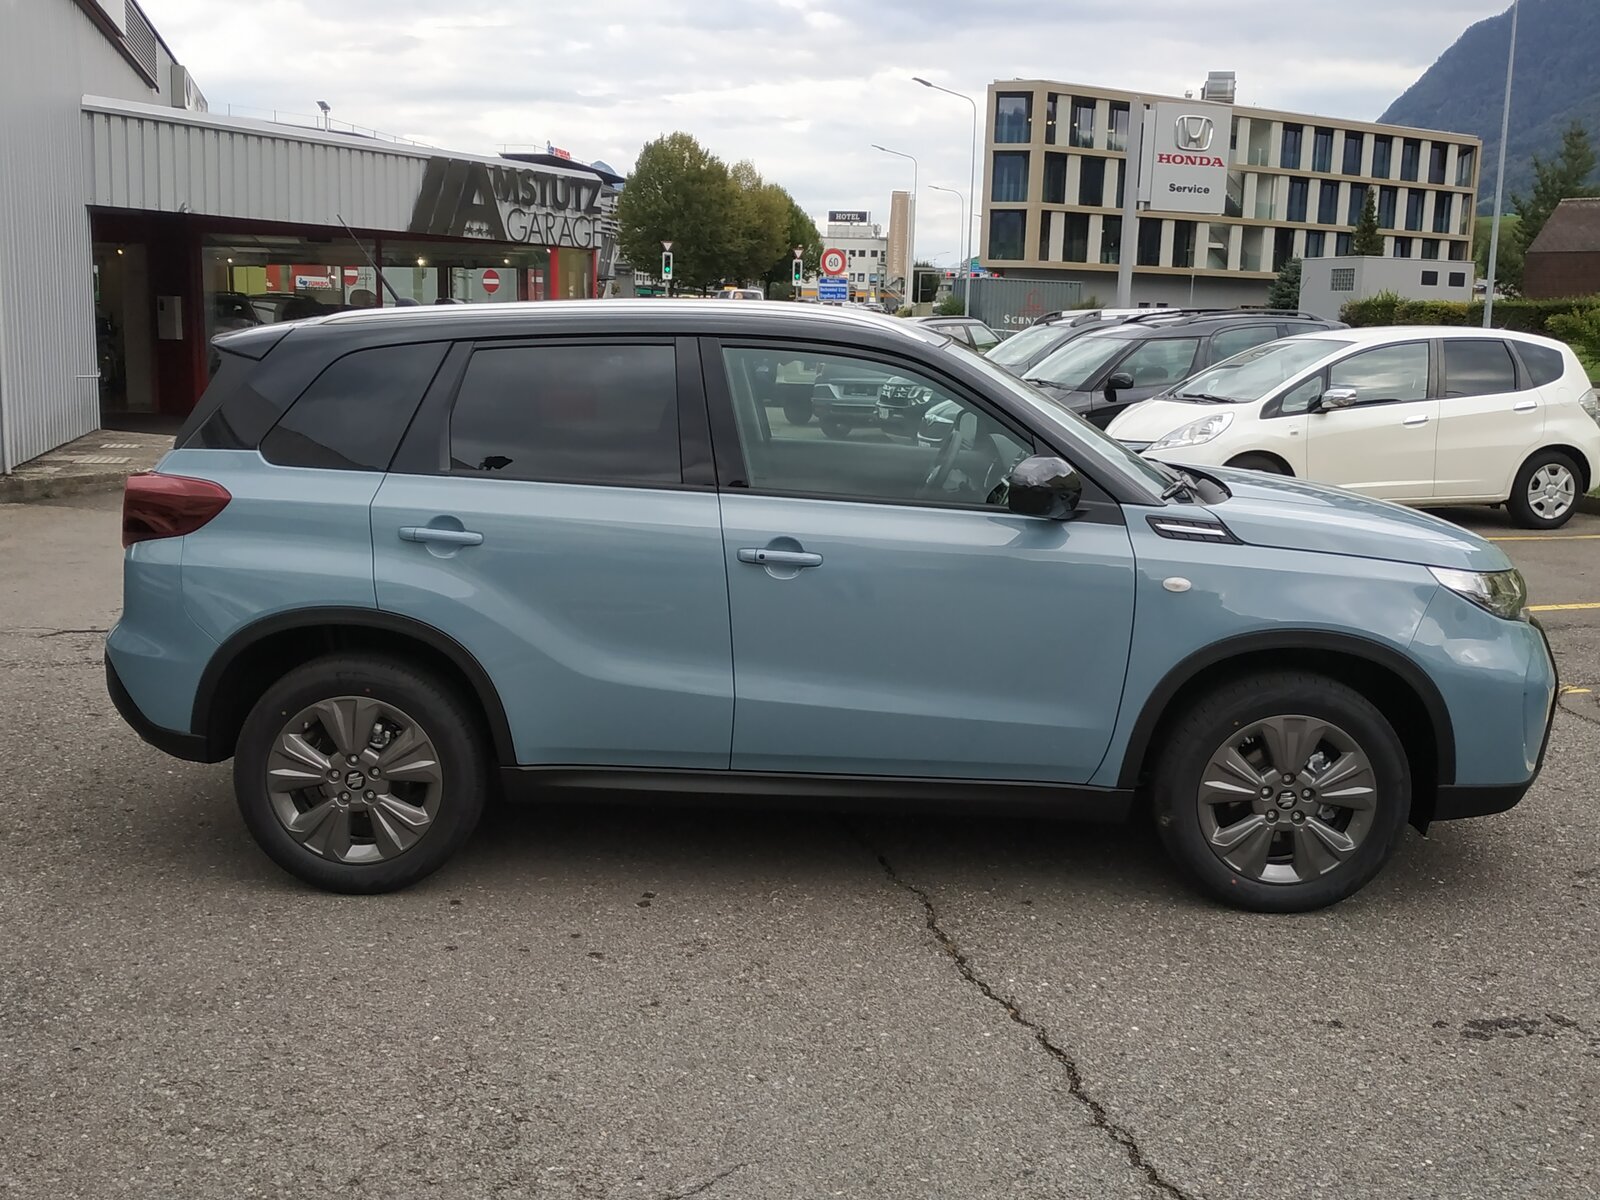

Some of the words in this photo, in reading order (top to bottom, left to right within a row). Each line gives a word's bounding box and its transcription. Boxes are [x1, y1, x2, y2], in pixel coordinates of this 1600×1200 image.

[1157, 153, 1225, 168] HONDA
[1168, 183, 1210, 195] Service
[450, 161, 602, 240] AMSTUTZ
[835, 213, 860, 221] HOTEL
[506, 208, 602, 249] GARAGE
[828, 257, 839, 267] 60
